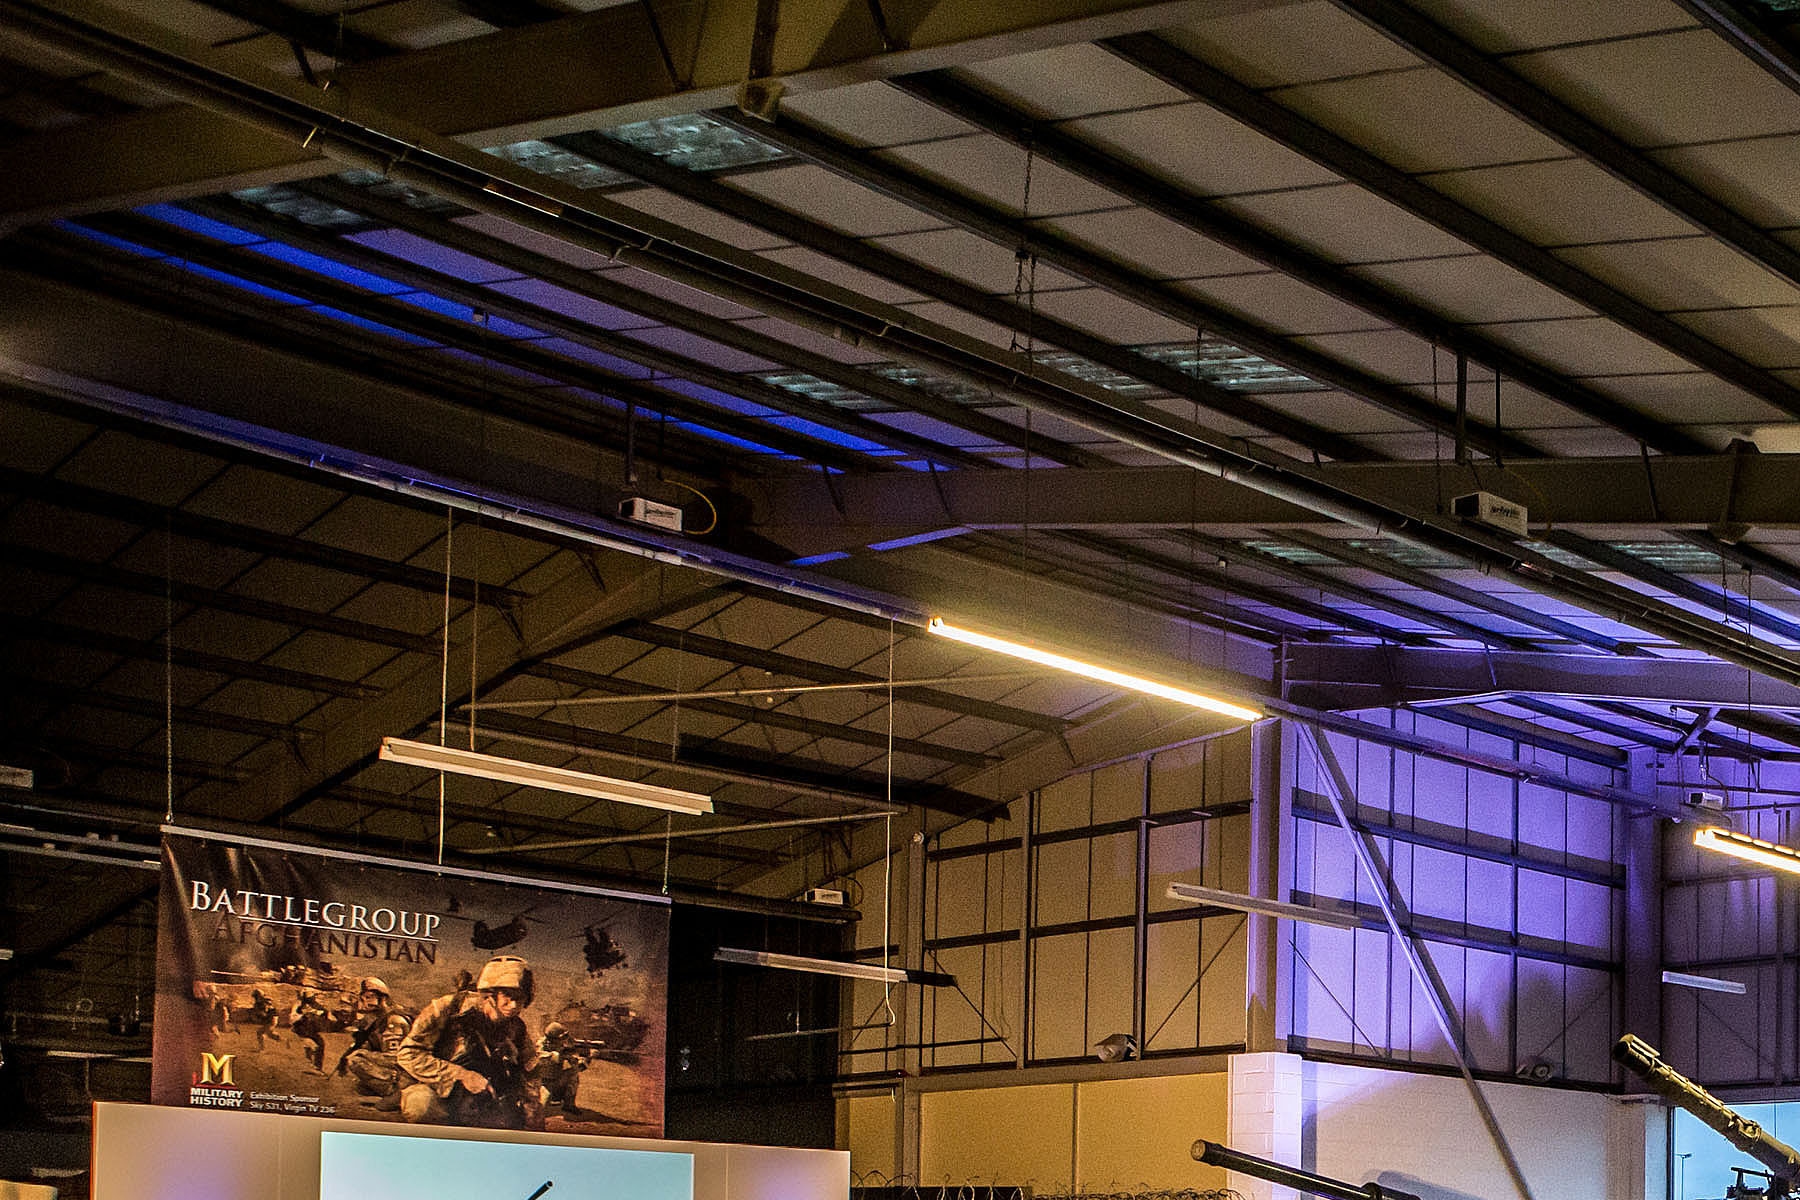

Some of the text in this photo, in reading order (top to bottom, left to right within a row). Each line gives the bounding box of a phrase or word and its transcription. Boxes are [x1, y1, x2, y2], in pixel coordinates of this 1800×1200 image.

[191, 880, 440, 937] BATTLEGROUP
[214, 912, 436, 964] AFGHANISTAN
[190, 1096, 243, 1107] HISTORY
[191, 1088, 243, 1099] MILITARY
